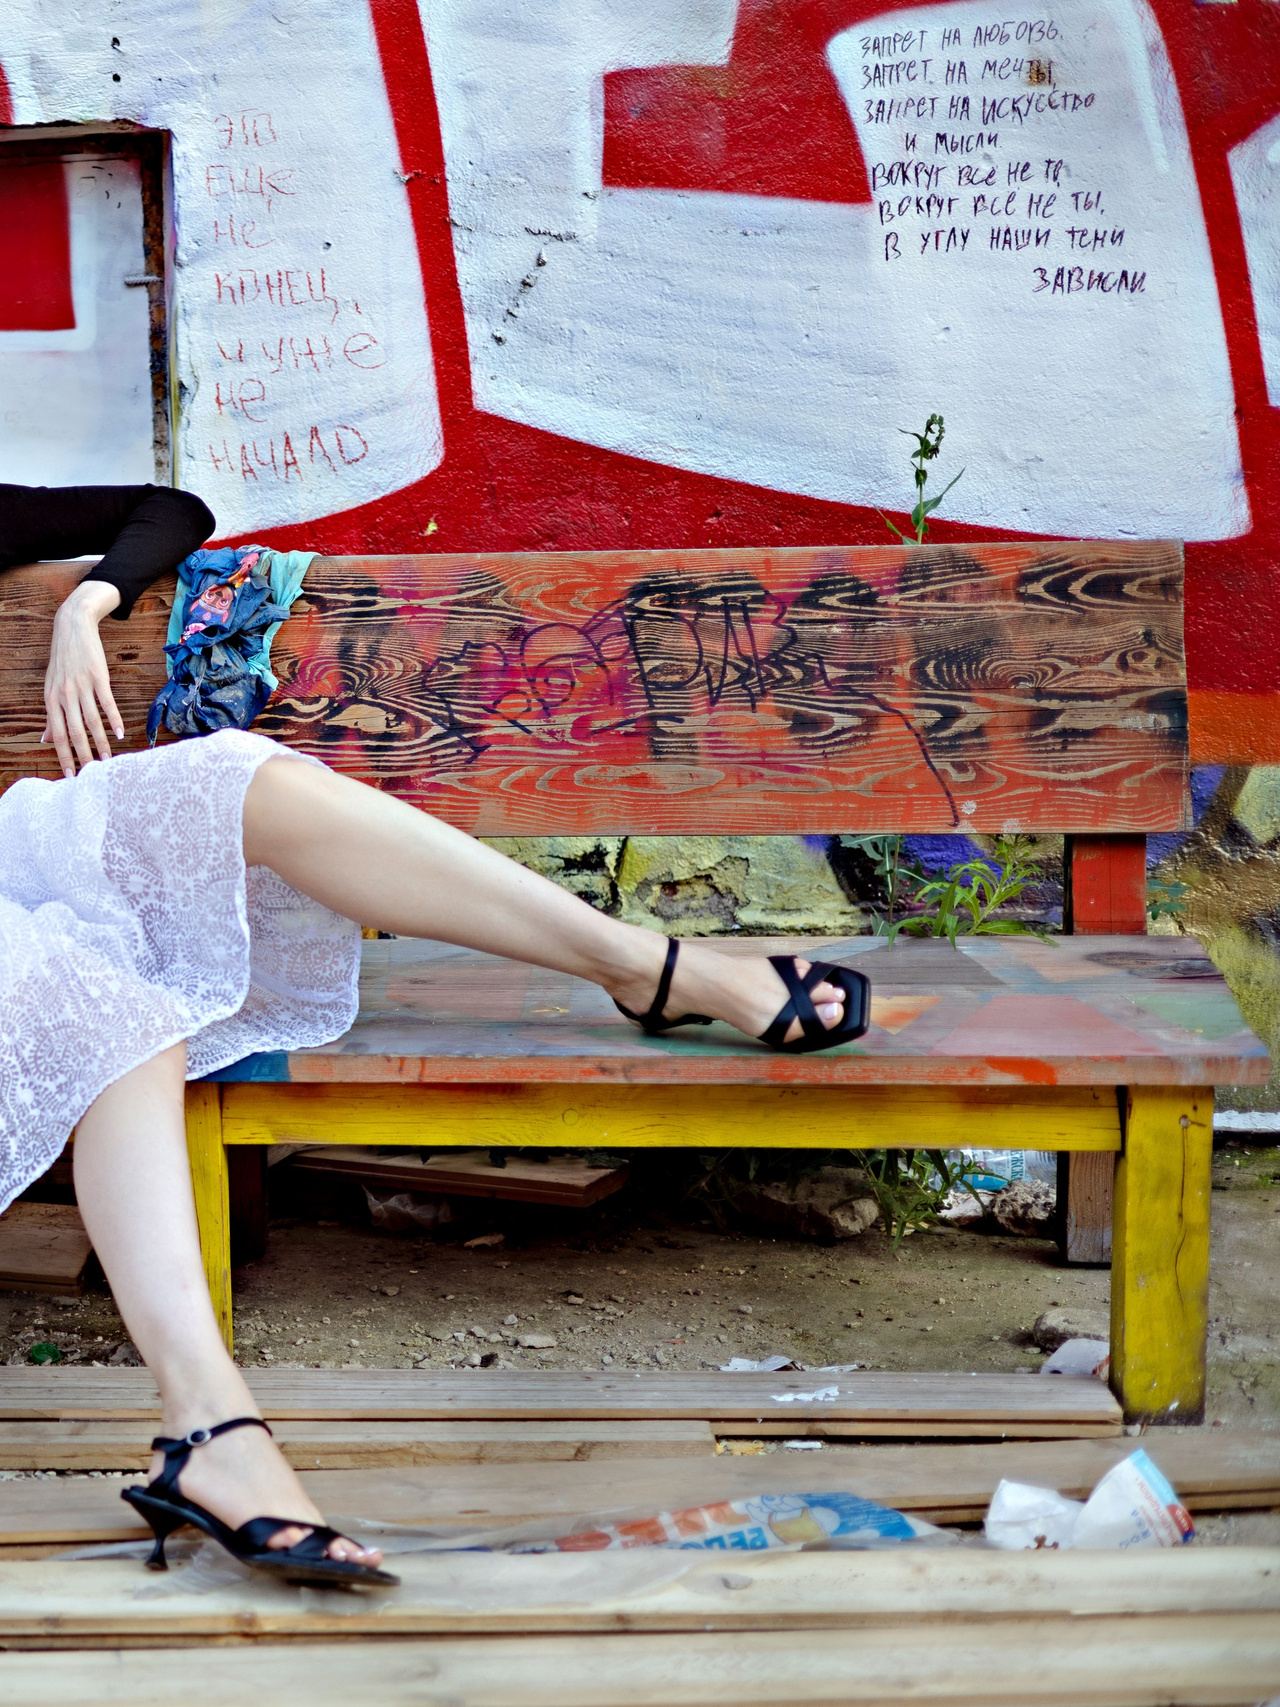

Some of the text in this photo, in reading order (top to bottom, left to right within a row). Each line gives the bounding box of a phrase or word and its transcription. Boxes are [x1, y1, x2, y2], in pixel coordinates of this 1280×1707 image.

[941, 27, 962, 51] НА
[945, 59, 968, 86] НА
[948, 94, 970, 121] НА
[214, 108, 277, 149] ЭТО
[905, 132, 917, 153] И
[885, 232, 901, 261] В
[920, 227, 971, 255] УГЛУ
[989, 226, 1052, 252] НАШИ
